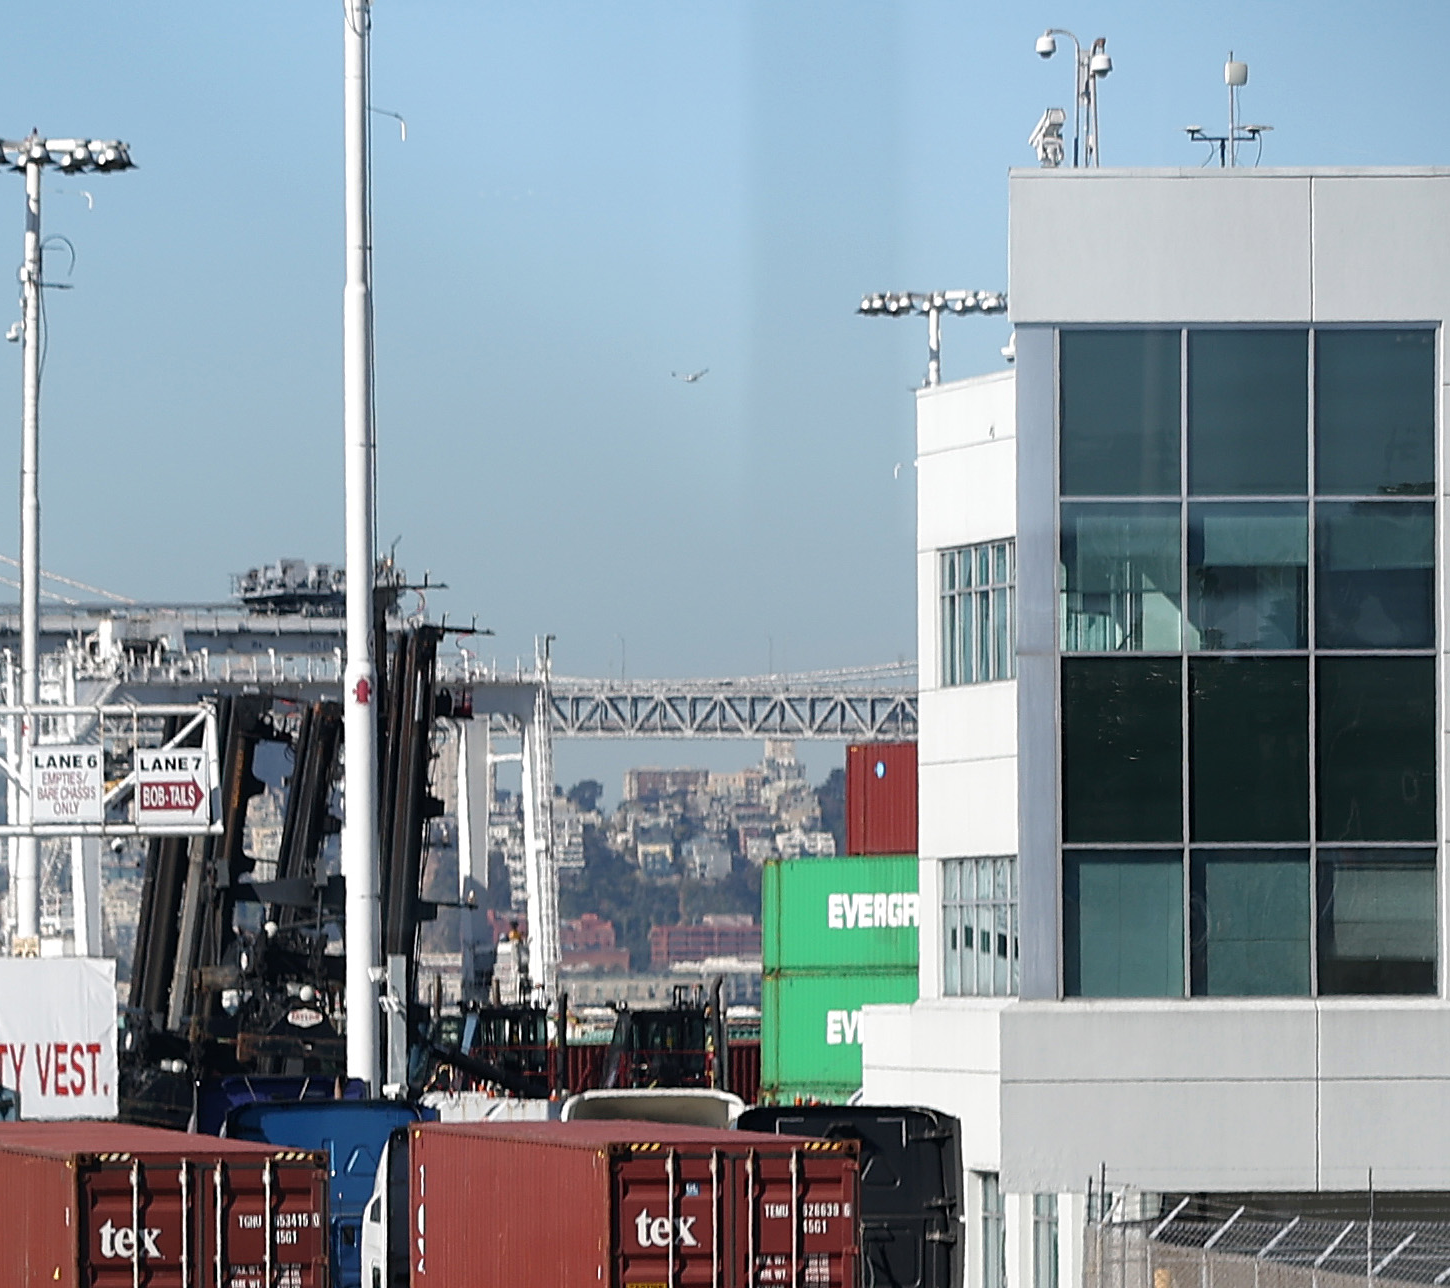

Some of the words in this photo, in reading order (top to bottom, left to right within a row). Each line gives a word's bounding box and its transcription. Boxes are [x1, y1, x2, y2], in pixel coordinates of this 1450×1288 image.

[35, 755, 82, 768] LANE
[87, 755, 97, 768] 6
[140, 758, 188, 771] LANE
[193, 757, 202, 770] 7
[53, 801, 80, 816] ONLY
[35, 1042, 109, 1097] VEST.
[765, 1203, 789, 1218] TEMU
[635, 1208, 702, 1248] tex
[99, 1218, 166, 1259] tex
